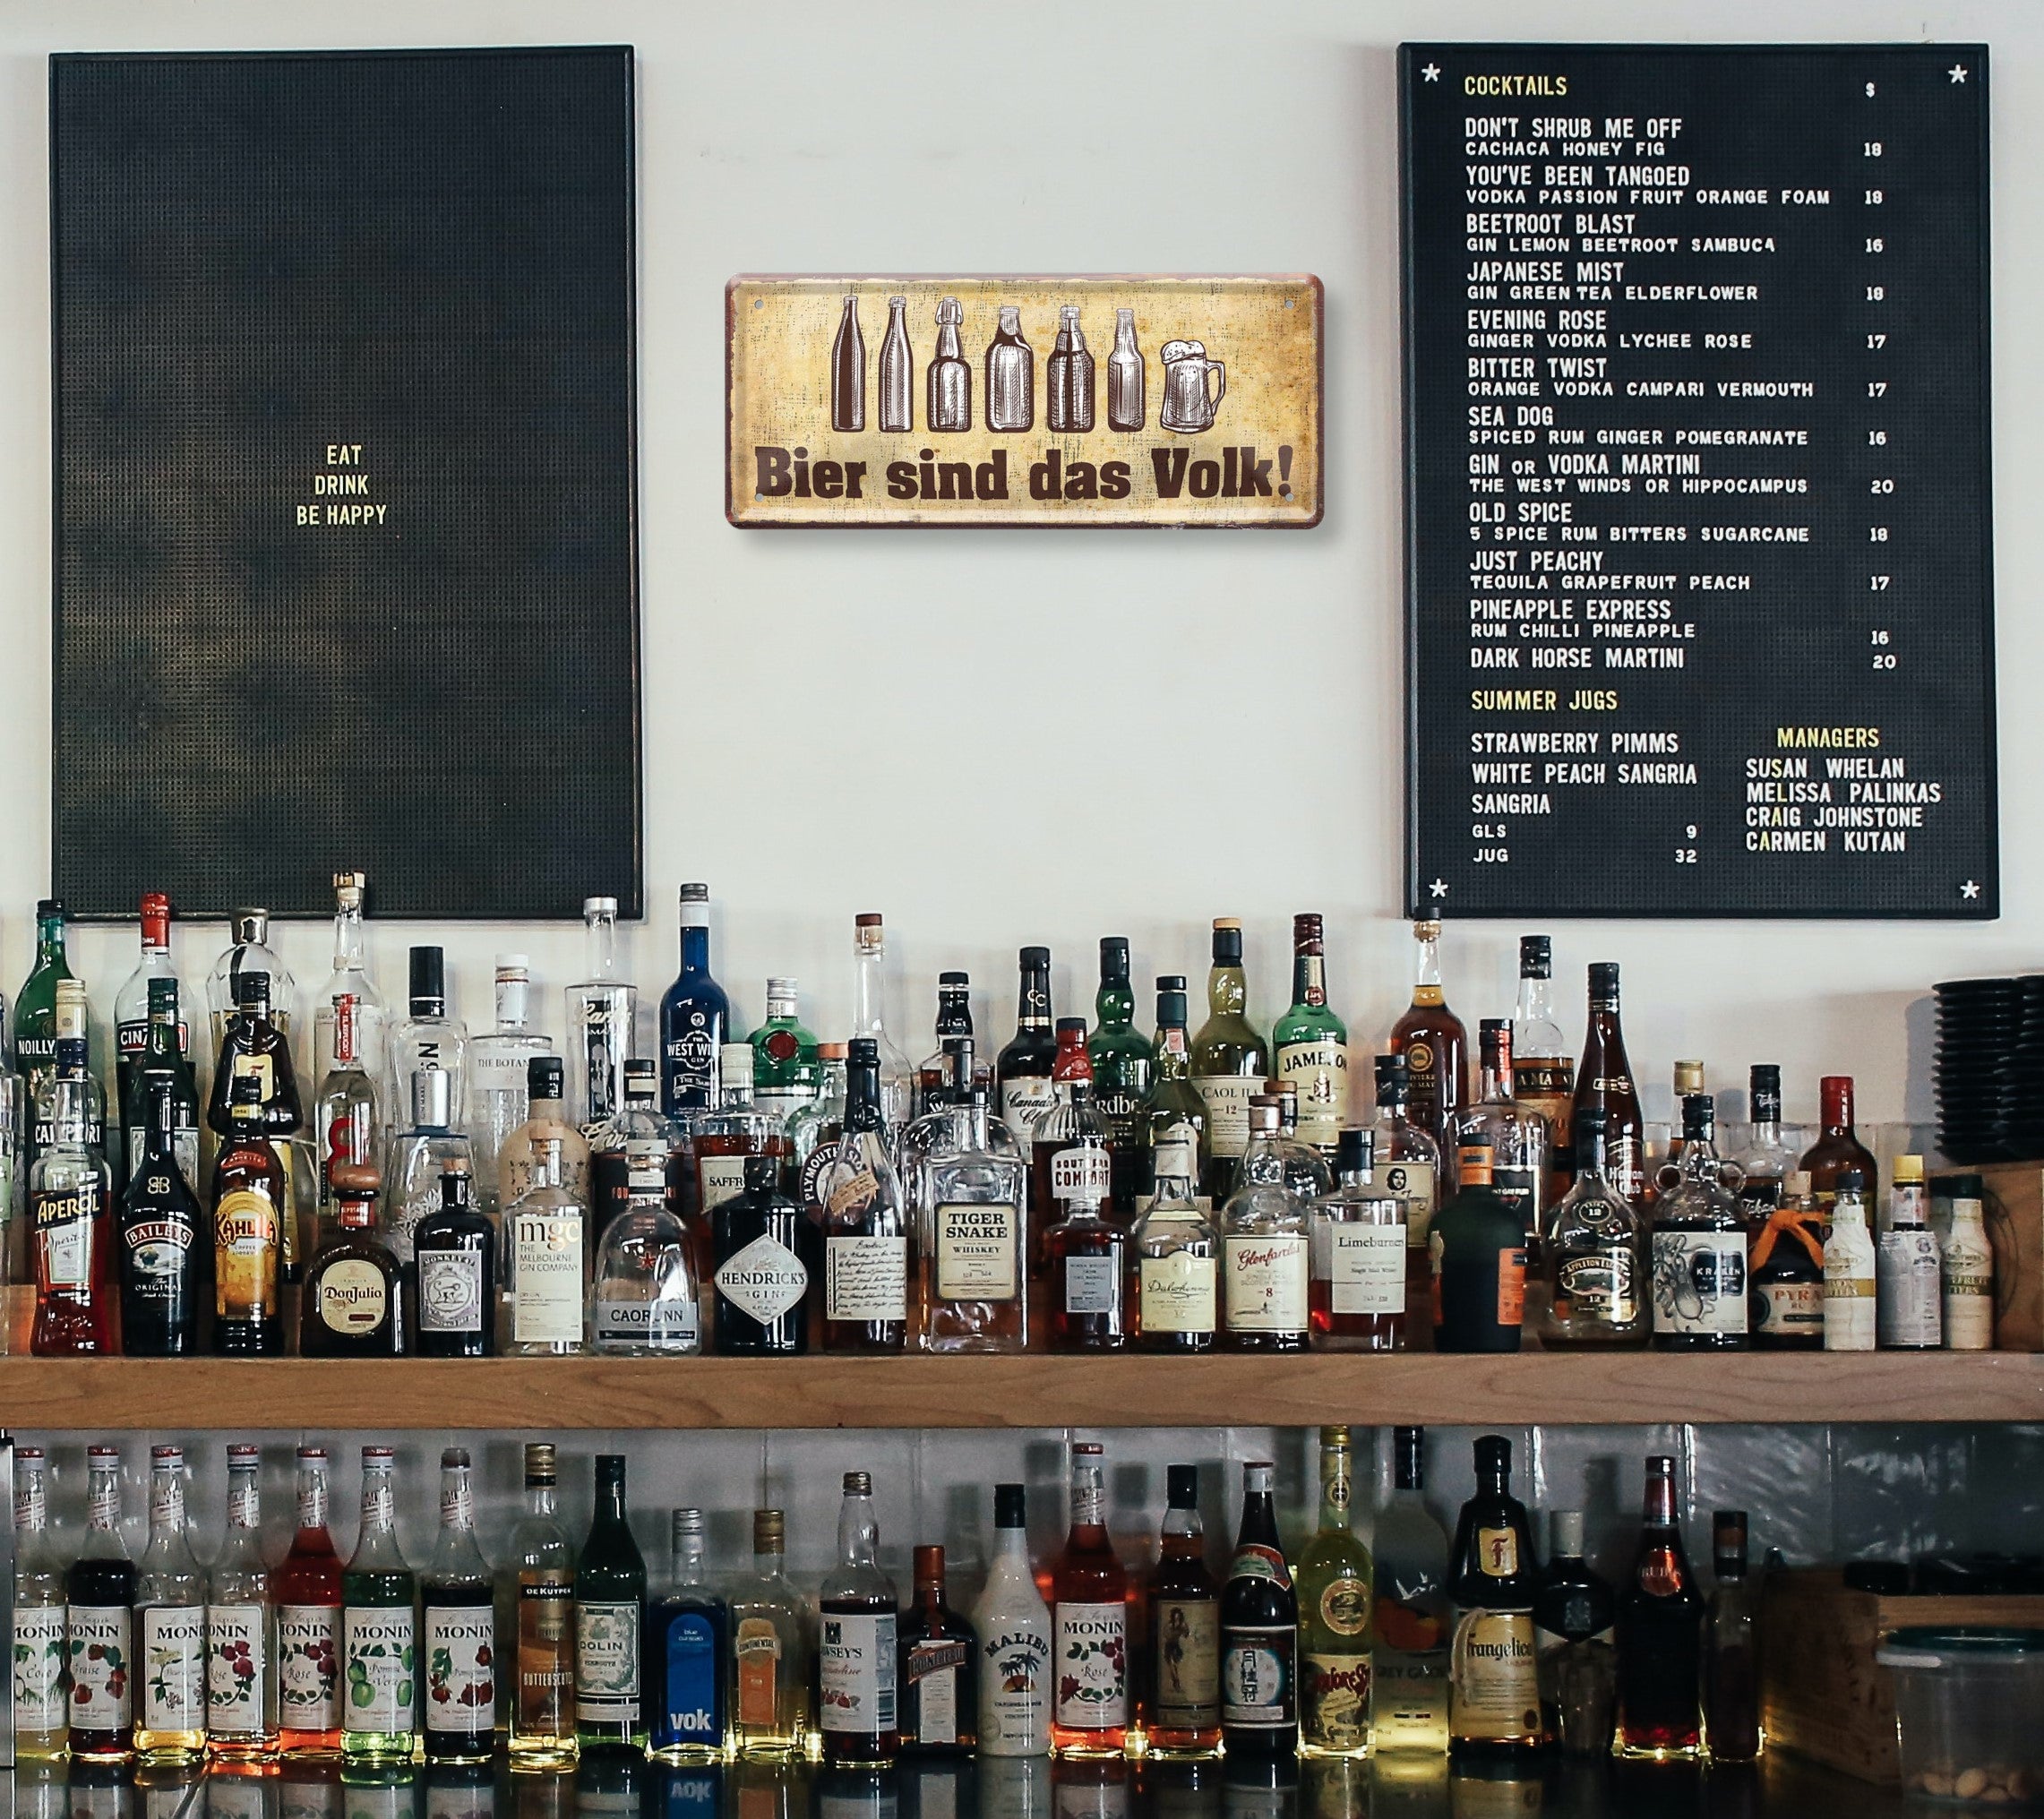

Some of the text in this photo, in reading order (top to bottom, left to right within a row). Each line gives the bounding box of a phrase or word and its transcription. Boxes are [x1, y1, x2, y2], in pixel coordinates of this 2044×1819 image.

[1464, 75, 1567, 96] COCKTAILS
[1464, 116, 1682, 139] DON'T SHRUB ME OFF
[1465, 141, 1665, 157] CACHACA HONEY FIG
[1864, 142, 1882, 158] 18
[1465, 164, 1690, 187] YOU'VE BEEN TANGOED
[1465, 189, 1830, 205] VODKA PASSION FRUIT ORANGE FOAM
[1865, 190, 1883, 205] 18
[1466, 213, 1636, 235] BEETROOT BLAST
[1466, 237, 1775, 253] GIN LEMON BEETROOT SAMBUCA
[1865, 238, 1884, 253] 16
[1466, 261, 1624, 283] JAPANESE MIST
[1467, 285, 1758, 301] GIN GREEN TEA ELDERFLOWER
[1866, 286, 1884, 301] 18
[1467, 309, 1607, 331] EVENING ROSE
[1467, 333, 1752, 349] GINGER VODKA LYCHEE ROSE
[1867, 334, 1886, 349] 17
[1468, 357, 1607, 379] BITTER TWIST
[1467, 381, 1814, 398] ORANGE VODKA CAMPARI VERMOUTH
[1868, 382, 1887, 398] 17
[1468, 406, 1554, 426] SEA DOG
[1469, 429, 1808, 446] SPICED RUM GINGER POMEGRANATE
[1868, 430, 1886, 446] 16
[326, 444, 362, 466] EAT
[754, 444, 1294, 501] Bier sind das Volk!
[1469, 453, 1700, 476] GIN OR VODKA MARTINI
[314, 474, 369, 496] DRINK
[1469, 477, 1808, 494] THE WEST WINDS OR HIPPOCAMPUS
[1870, 479, 1894, 494] 20
[296, 503, 387, 526] BE HAPPY
[1469, 502, 1572, 523] OLD SPICE
[1469, 526, 1809, 543] 5 SPICE RUM BITTERS SUGARCANE
[1870, 527, 1888, 542] 18
[1469, 550, 1603, 572] JUST PEACHY
[1470, 574, 1750, 590] TEQUILA GRAPEFRUIT PEACH
[1870, 576, 1890, 591] 17
[1470, 598, 1671, 621] PINEAPPLE EXPRESS
[1471, 622, 1696, 639] RUM CHILLI PINEAPPLE
[1870, 630, 1889, 646] 16
[1471, 647, 1684, 669] DARK HORSE MARTINI
[1872, 654, 1897, 670] 20
[1471, 690, 1618, 711] SUMMER JUGS
[1471, 732, 1679, 754] STRAWBERRY PIMMS
[1777, 727, 1880, 749] MANAGERS
[1472, 762, 1697, 785] WHITE PEACH SANGRIA
[1746, 757, 1904, 779] SUSAN WHELAN
[1747, 782, 1942, 804] MELISSA PALINKAS
[1472, 793, 1551, 815] SANGRIA
[1746, 806, 1923, 828] CRAIG JOHNSTONE
[1472, 824, 1507, 838] GLS
[1686, 824, 1697, 839] 9
[1746, 830, 1905, 853] CARMEN KUTAN
[1473, 847, 1508, 862] JUG
[1675, 848, 1697, 863] 32
[18, 1039, 56, 1055] NOILLY
[666, 1042, 694, 1057] WEST
[478, 1058, 493, 1068] THE
[1284, 1051, 1347, 1073] JAMEON
[1201, 1086, 1238, 1098] CAOL
[1225, 1105, 1237, 1115] 12
[1056, 1158, 1109, 1169] SOUTERN
[803, 1145, 840, 1202] PLYMOUTH
[38, 1193, 100, 1224] APEROL
[948, 1213, 1005, 1225] TIGER
[129, 1225, 190, 1243] BAILEYS
[214, 1213, 279, 1247] KAHLA
[520, 1221, 580, 1251] mgc
[946, 1226, 1009, 1239] SNAKE
[520, 1244, 536, 1252] THE
[952, 1246, 1001, 1254] WHISKEY
[520, 1264, 579, 1272] GIN COMPANY
[721, 1272, 805, 1285] HENDRICK'S
[751, 1291, 780, 1300] GIN
[1266, 1287, 1273, 1297] 8
[353, 1626, 411, 1639] MONIN
[435, 1626, 493, 1638] MONIN
[1064, 1621, 1123, 1635] MONIN
[580, 1641, 623, 1651] DOLIN
[984, 1632, 1050, 1657] MALIBU
[670, 1709, 712, 1730] vok
